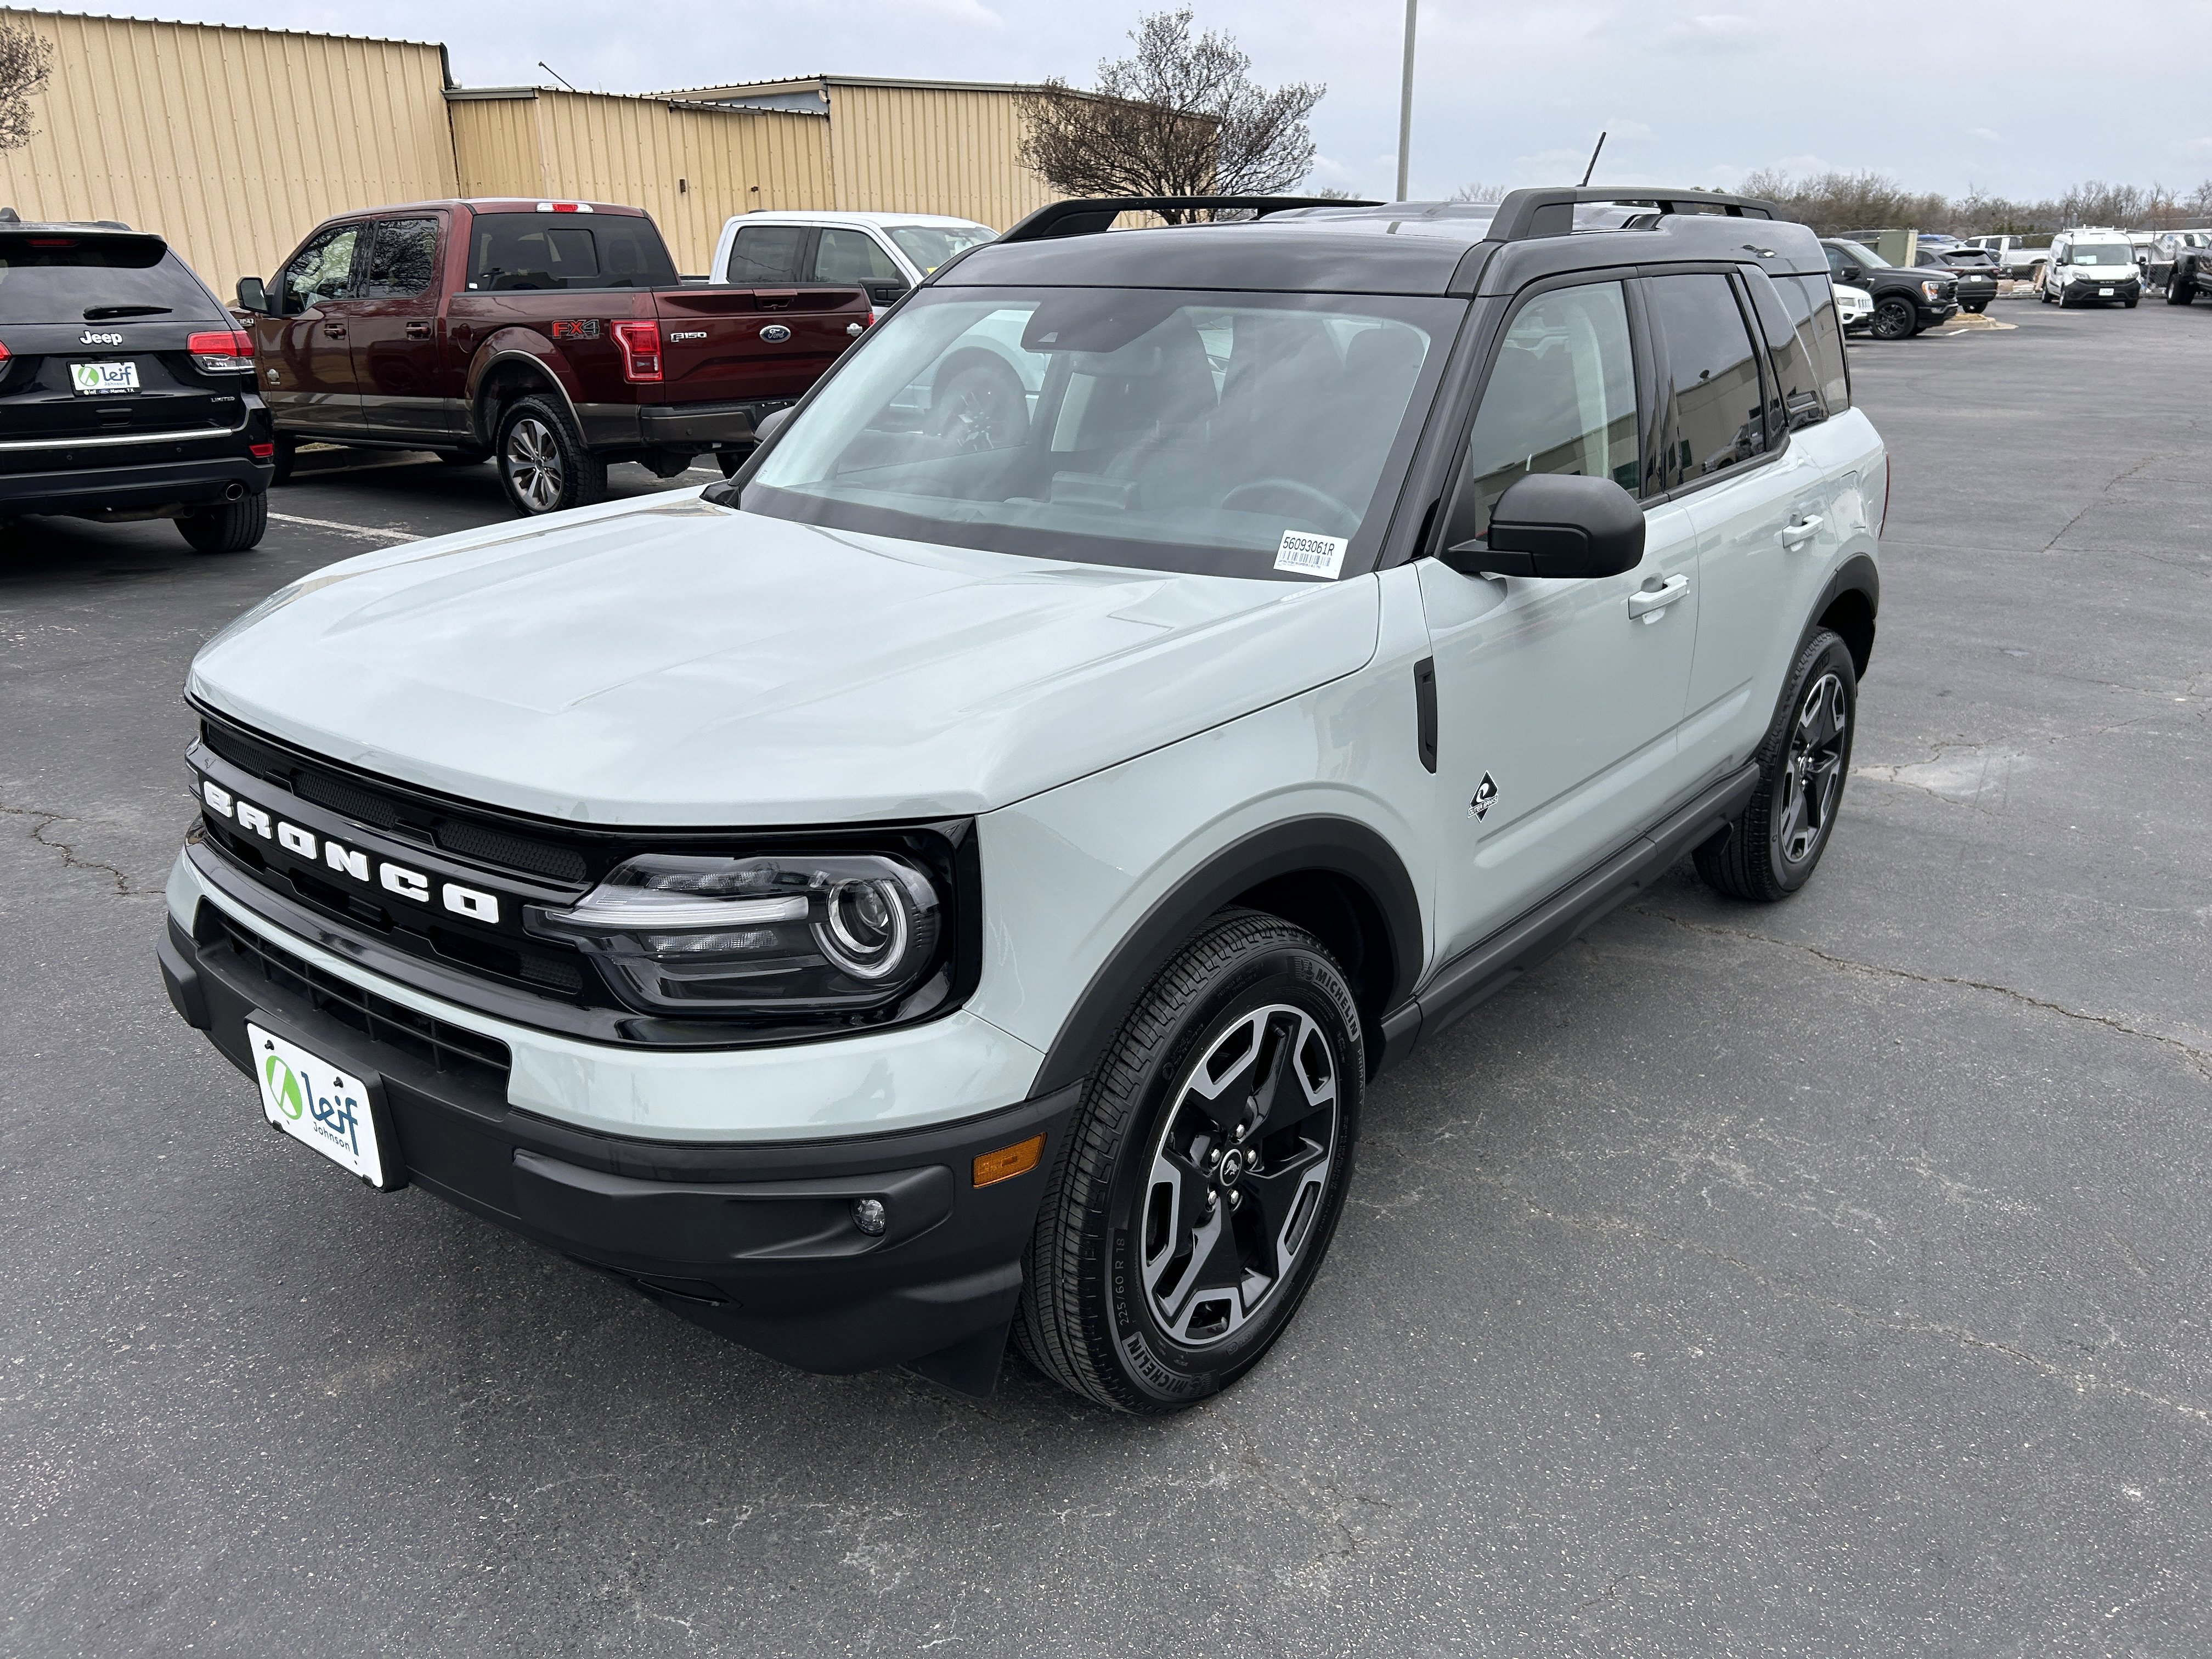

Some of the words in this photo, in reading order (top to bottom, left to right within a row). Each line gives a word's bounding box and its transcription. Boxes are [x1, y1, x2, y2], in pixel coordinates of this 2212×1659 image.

[79, 330, 123, 346] Jeep
[552, 319, 600, 339] FX4
[768, 329, 785, 338] Ford
[1283, 537, 1335, 556] 56093061R
[204, 780, 500, 924] BRONCO
[1315, 968, 1358, 1034] MICHELIN
[313, 1121, 351, 1152] Johnson
[1116, 1238, 1125, 1252] 18
[1115, 1260, 1124, 1269] R
[1115, 1276, 1129, 1326] 225/60
[1127, 1338, 1190, 1394] MICHELIN
